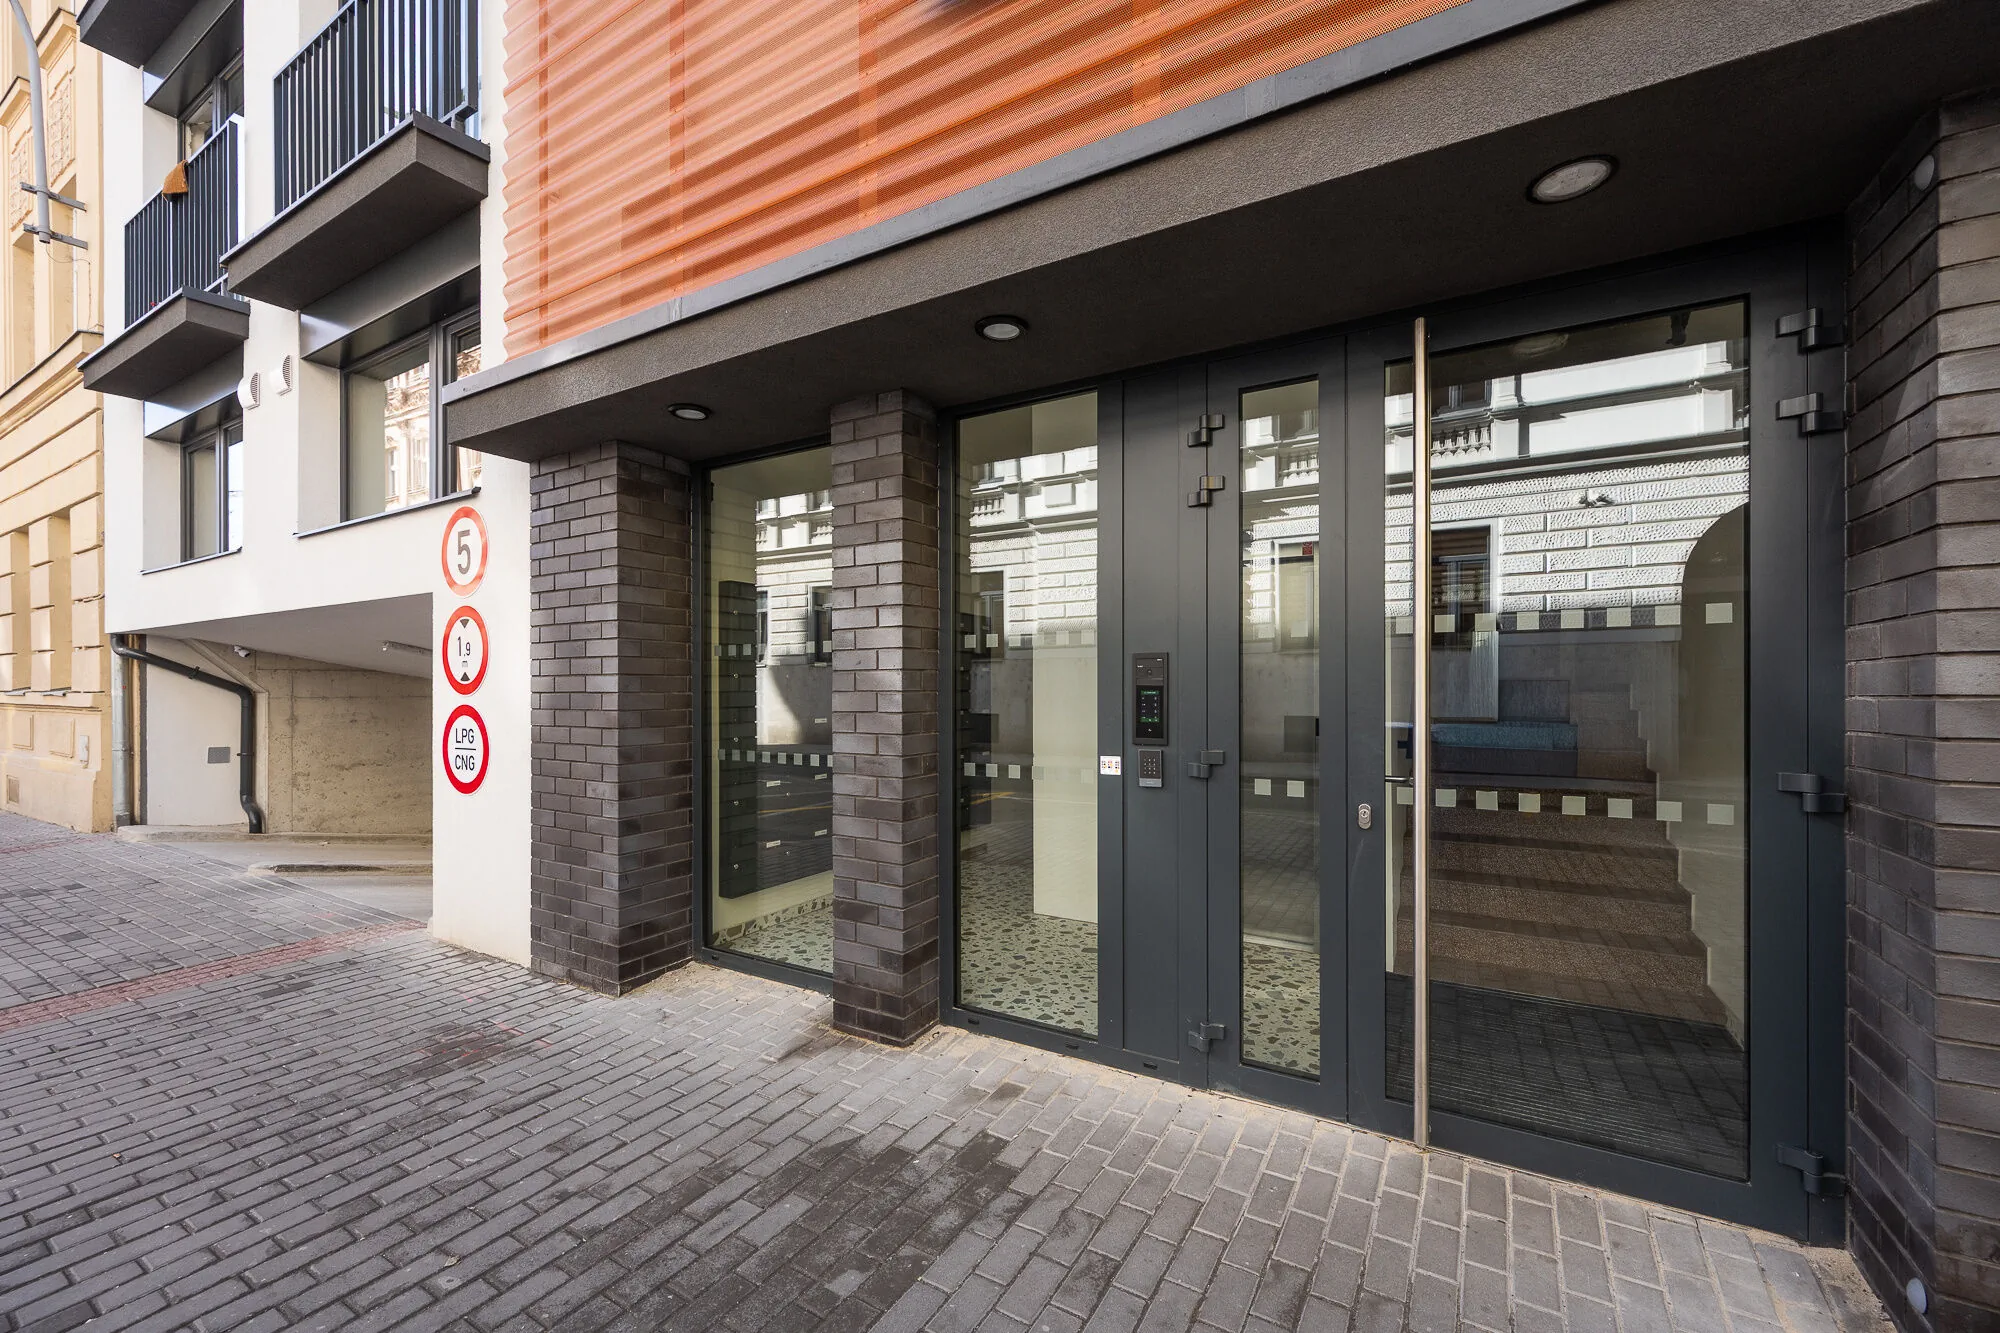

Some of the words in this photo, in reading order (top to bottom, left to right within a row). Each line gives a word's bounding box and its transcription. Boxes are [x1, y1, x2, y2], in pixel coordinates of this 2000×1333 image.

[457, 529, 471, 575] 5
[455, 728, 475, 744] LPG
[454, 754, 475, 771] CNG
